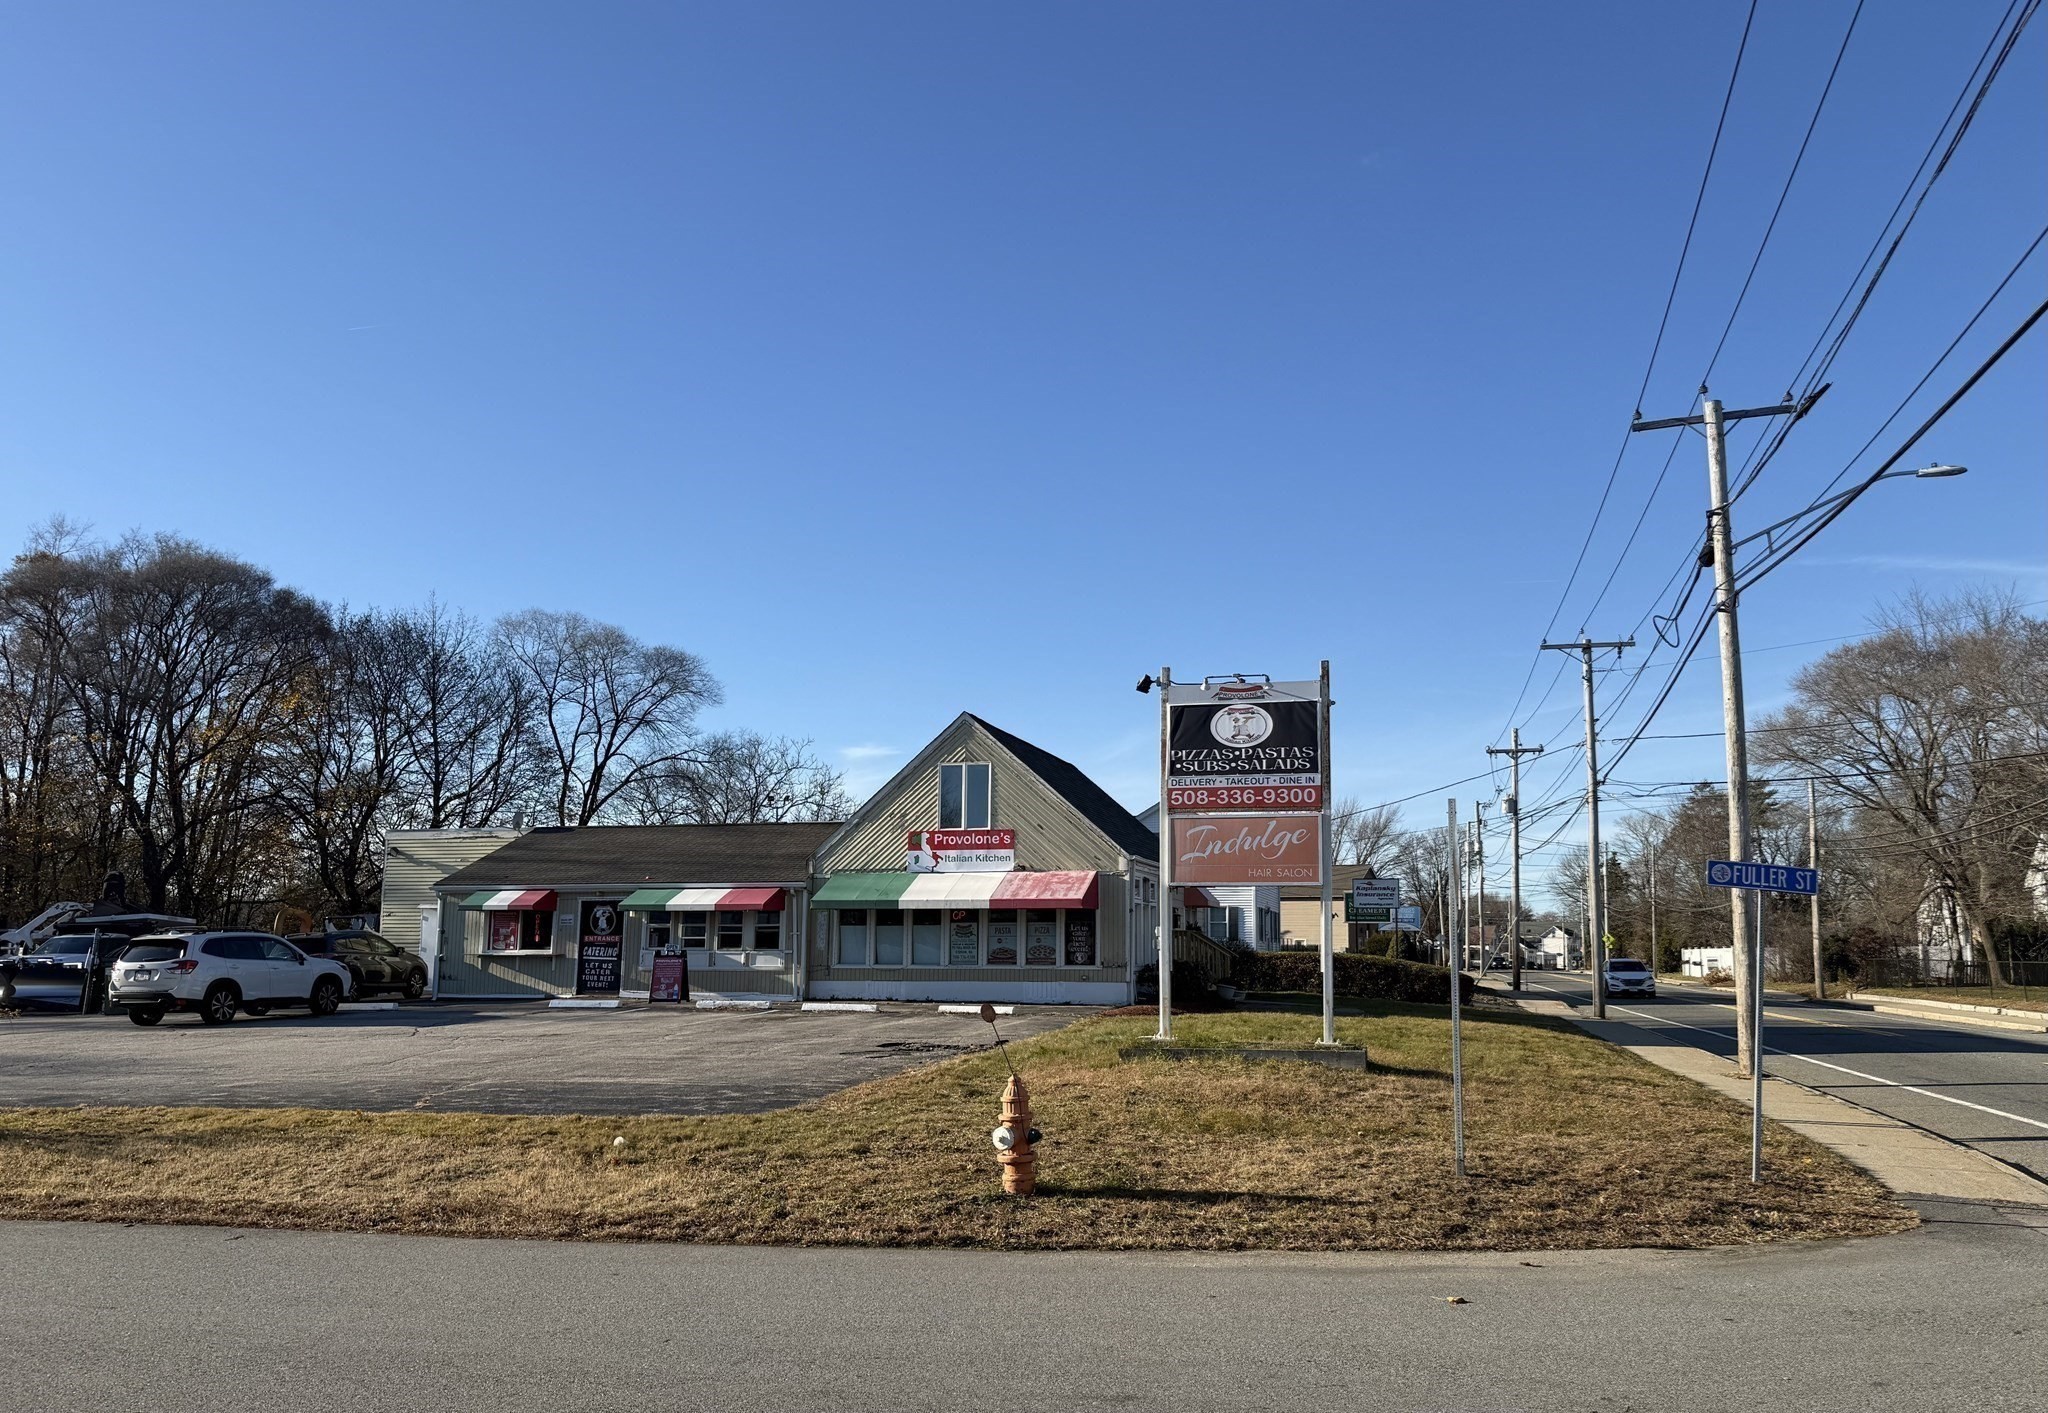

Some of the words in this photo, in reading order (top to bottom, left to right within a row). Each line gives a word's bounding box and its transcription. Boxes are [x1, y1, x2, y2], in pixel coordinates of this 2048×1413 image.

[1171, 778, 1217, 787] DELIVERY
[1225, 777, 1271, 786] TAKEOUT
[1279, 776, 1302, 785] DINE
[1305, 776, 1315, 784] IN
[1170, 788, 1316, 805] 508-336-9300
[934, 833, 1011, 845] Provolone's
[1180, 820, 1311, 864] Indulge
[944, 854, 973, 863] Italian
[975, 853, 1011, 862] Kitchen
[1248, 868, 1272, 878] HAIR
[1276, 868, 1313, 877] SALON
[1733, 865, 1787, 888] FULLER
[1795, 871, 1812, 890] ST
[994, 927, 1011, 935] PASTA
[1034, 926, 1050, 934] PIZZA
[583, 946, 617, 957] CATERING
